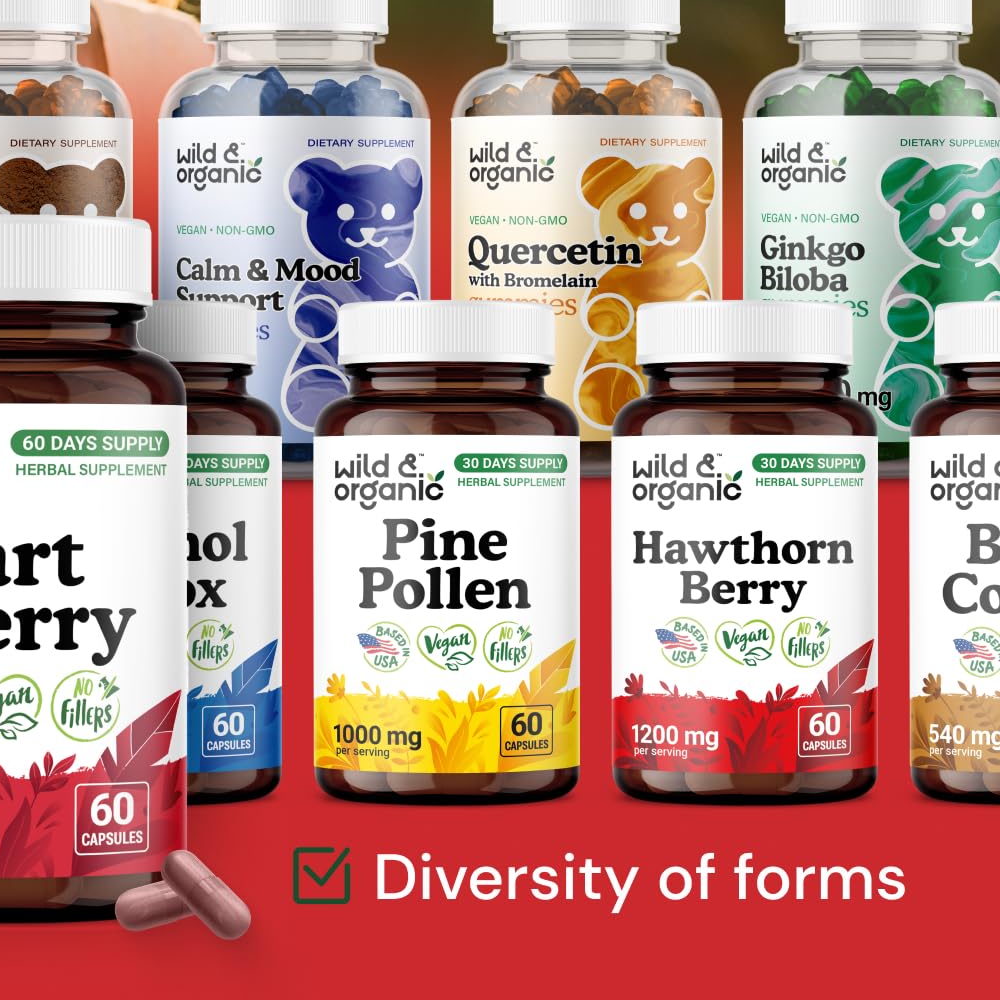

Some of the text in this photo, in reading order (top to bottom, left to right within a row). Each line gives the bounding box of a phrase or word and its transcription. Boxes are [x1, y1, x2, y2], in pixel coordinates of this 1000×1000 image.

[10, 139, 118, 148] DIETARY SUPPLEMENT
[308, 139, 414, 147] DIETARY SUPPLEMENT
[470, 143, 508, 163] wild
[470, 162, 554, 190] organic
[470, 216, 567, 225] VEGAN NON-GMO
[761, 214, 859, 223] VEGAN NON-GMO
[177, 225, 275, 235] VEGAN NON-GMO
[468, 236, 642, 269] Quercetin
[761, 235, 864, 266] Ginkgo
[177, 258, 360, 281] Calm & Mood
[760, 267, 848, 292] Biloba
[469, 275, 597, 288] with Bromelain
[858, 391, 892, 411] mg
[22, 436, 163, 452] 60 DAYS SUPPLY
[16, 464, 167, 477] HERBAL SUPPLEMENT
[335, 453, 389, 478] wild
[463, 458, 563, 469] 30 DAYS SUPPLY
[633, 454, 687, 478] wild
[760, 458, 861, 469] 30 DAYS SUPPLY
[335, 473, 443, 510] organic
[458, 478, 565, 487] HERBAL SUPPLEMENT
[633, 474, 742, 510] organic
[756, 478, 864, 487] HERBAL SUPPLEMENT
[382, 518, 507, 561] Pine
[633, 530, 853, 565] Hawthorn
[359, 567, 531, 610] Pollen
[680, 571, 807, 612] Berry
[424, 633, 472, 656] Vegan
[213, 712, 244, 736] 60
[511, 712, 542, 736] 60
[809, 712, 840, 736] 60
[929, 724, 965, 744] 540
[207, 739, 251, 751] CAPSULES
[334, 724, 422, 750] 1000 mg
[505, 740, 548, 751] CAPSULES
[632, 724, 719, 750] 1200 mg
[803, 739, 846, 750] CAPSULES
[336, 747, 389, 758] per serving
[634, 747, 688, 759] per serving
[930, 746, 982, 759] per serving
[91, 792, 134, 825] 60
[82, 830, 143, 847] CAPSULES
